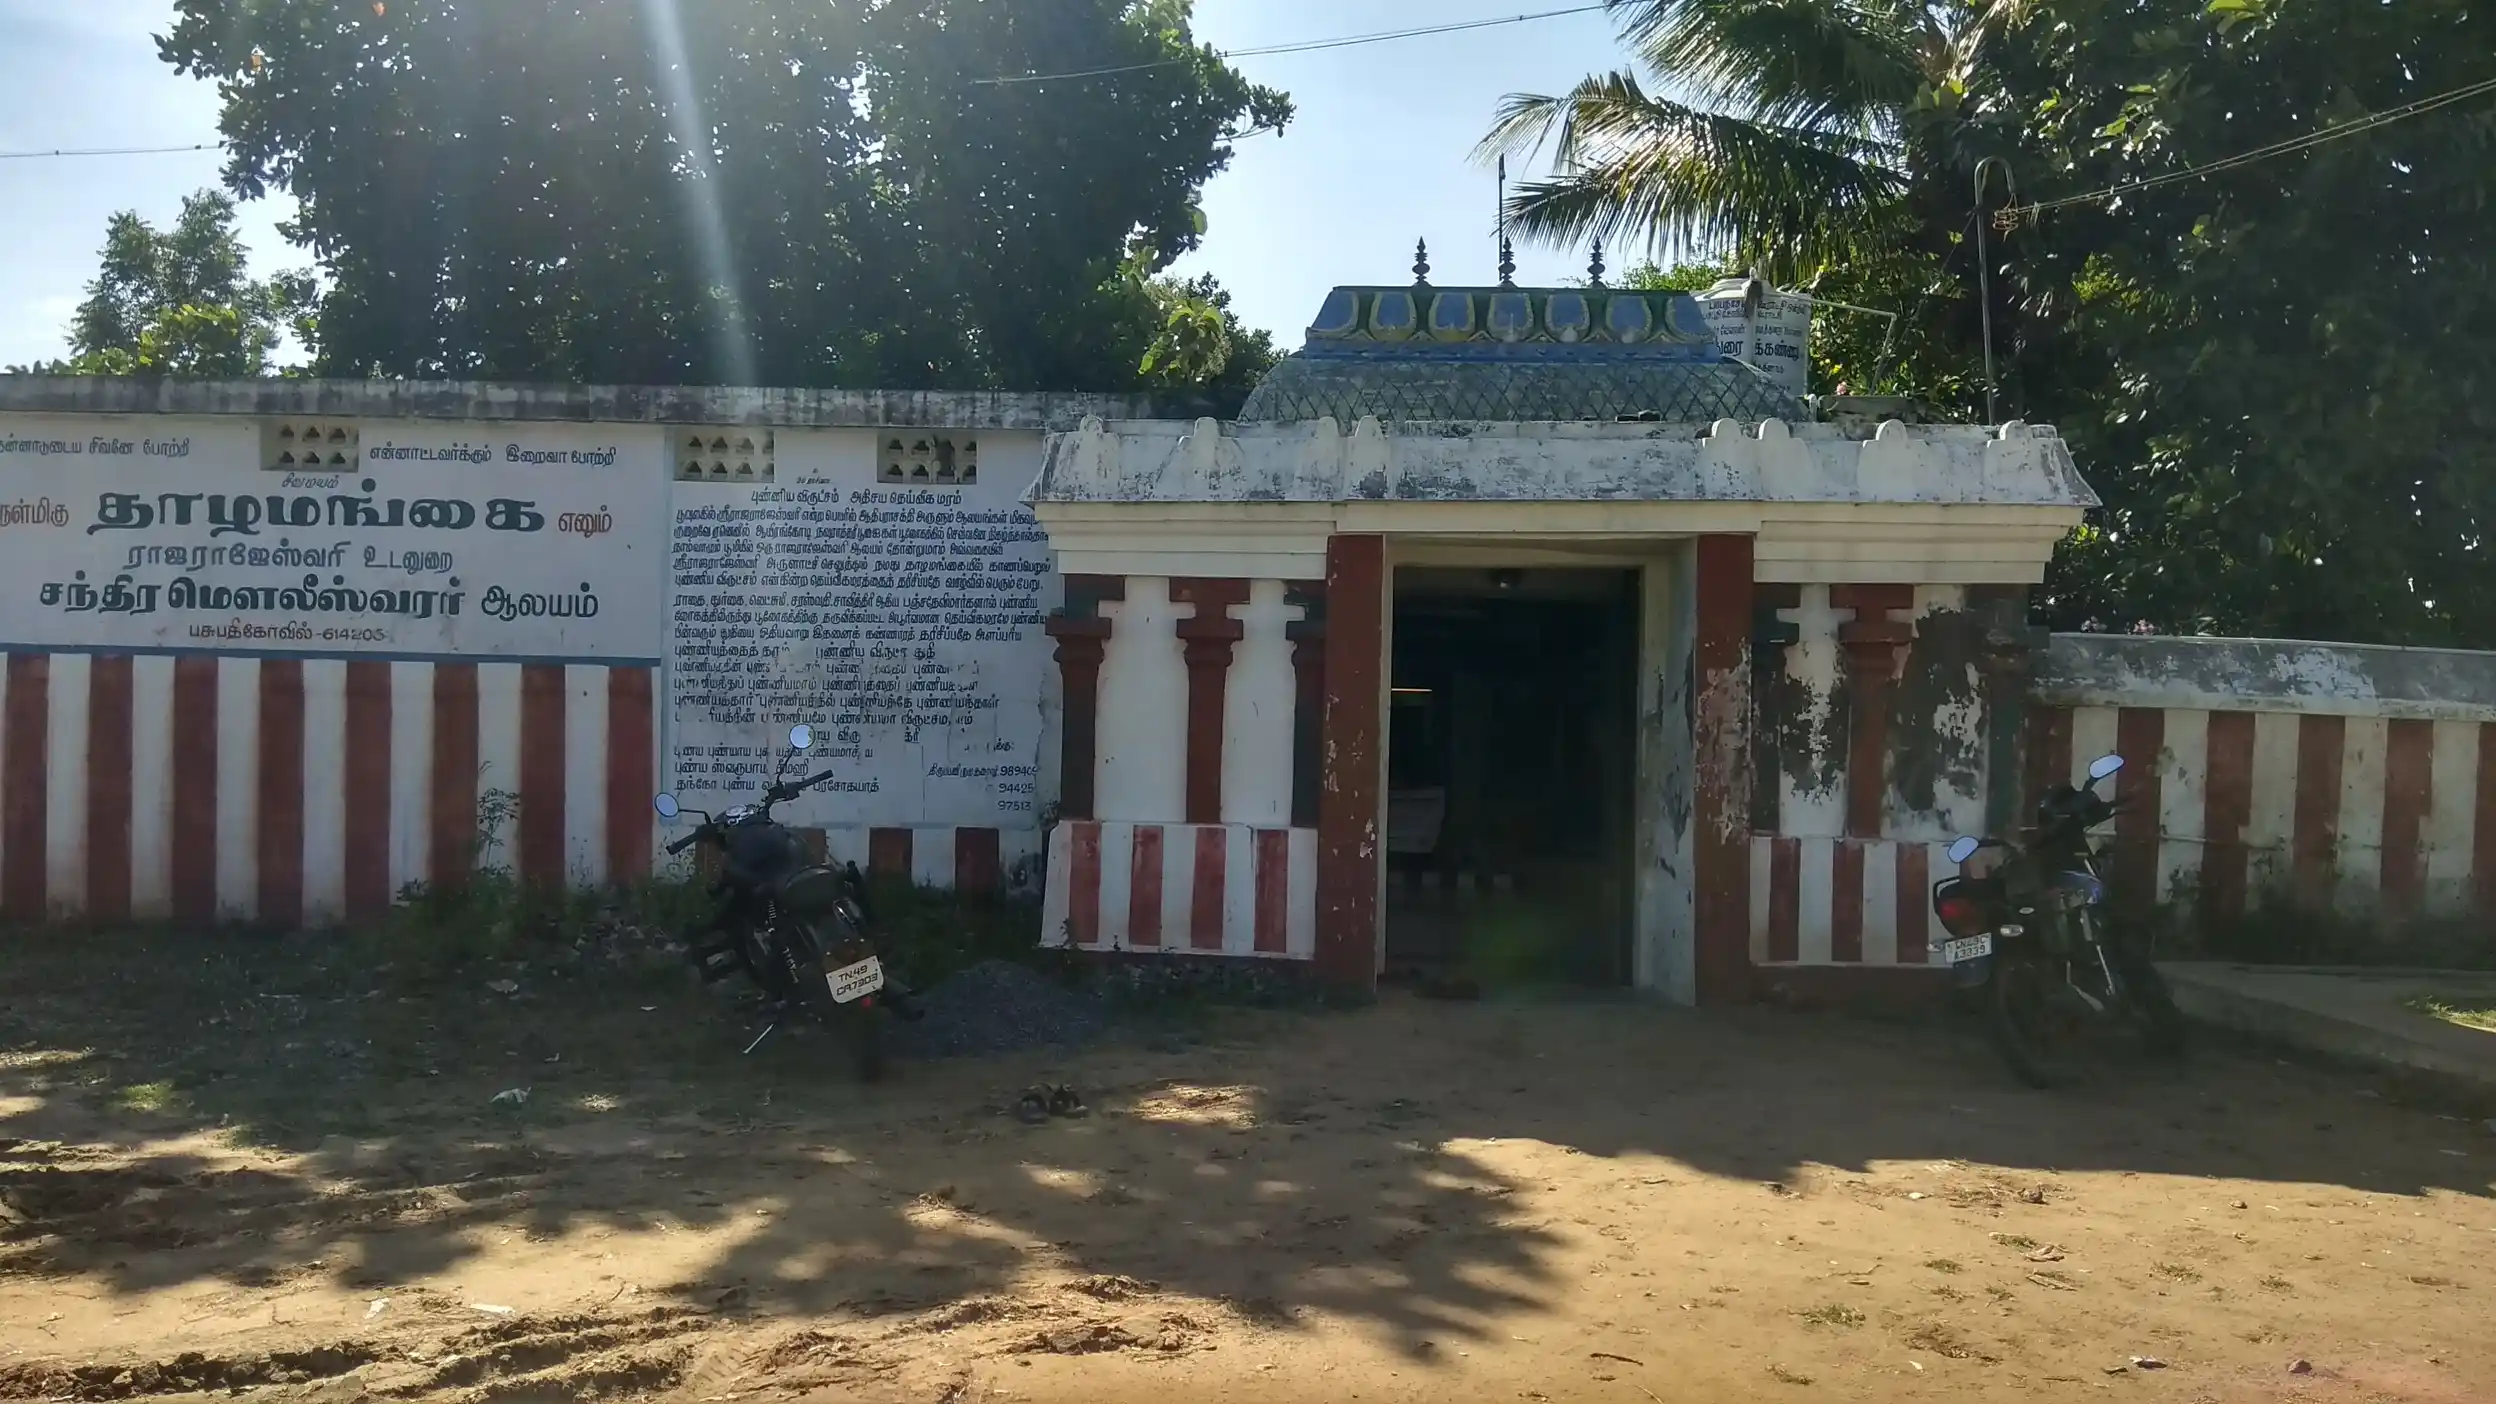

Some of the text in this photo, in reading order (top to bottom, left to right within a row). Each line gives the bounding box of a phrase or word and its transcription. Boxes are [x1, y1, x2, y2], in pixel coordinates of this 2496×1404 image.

[89, 436, 134, 455] சிவனே
[143, 437, 190, 457] போற்றி
[370, 441, 617, 467] என்னாட்டவர்க்கும் இறைவா போற்றி
[86, 477, 546, 538] தாழமங்கை
[558, 504, 613, 538] எனும்
[751, 486, 794, 505] புண்ணிய
[850, 488, 888, 504] அதிசய
[937, 489, 962, 507] மரம்
[802, 507, 824, 523] என்ற
[122, 537, 453, 575] ராஜராஜேஸ்வரி உடனுறை
[675, 570, 714, 587] புண்ணிய
[481, 581, 600, 622] ஆலயம்
